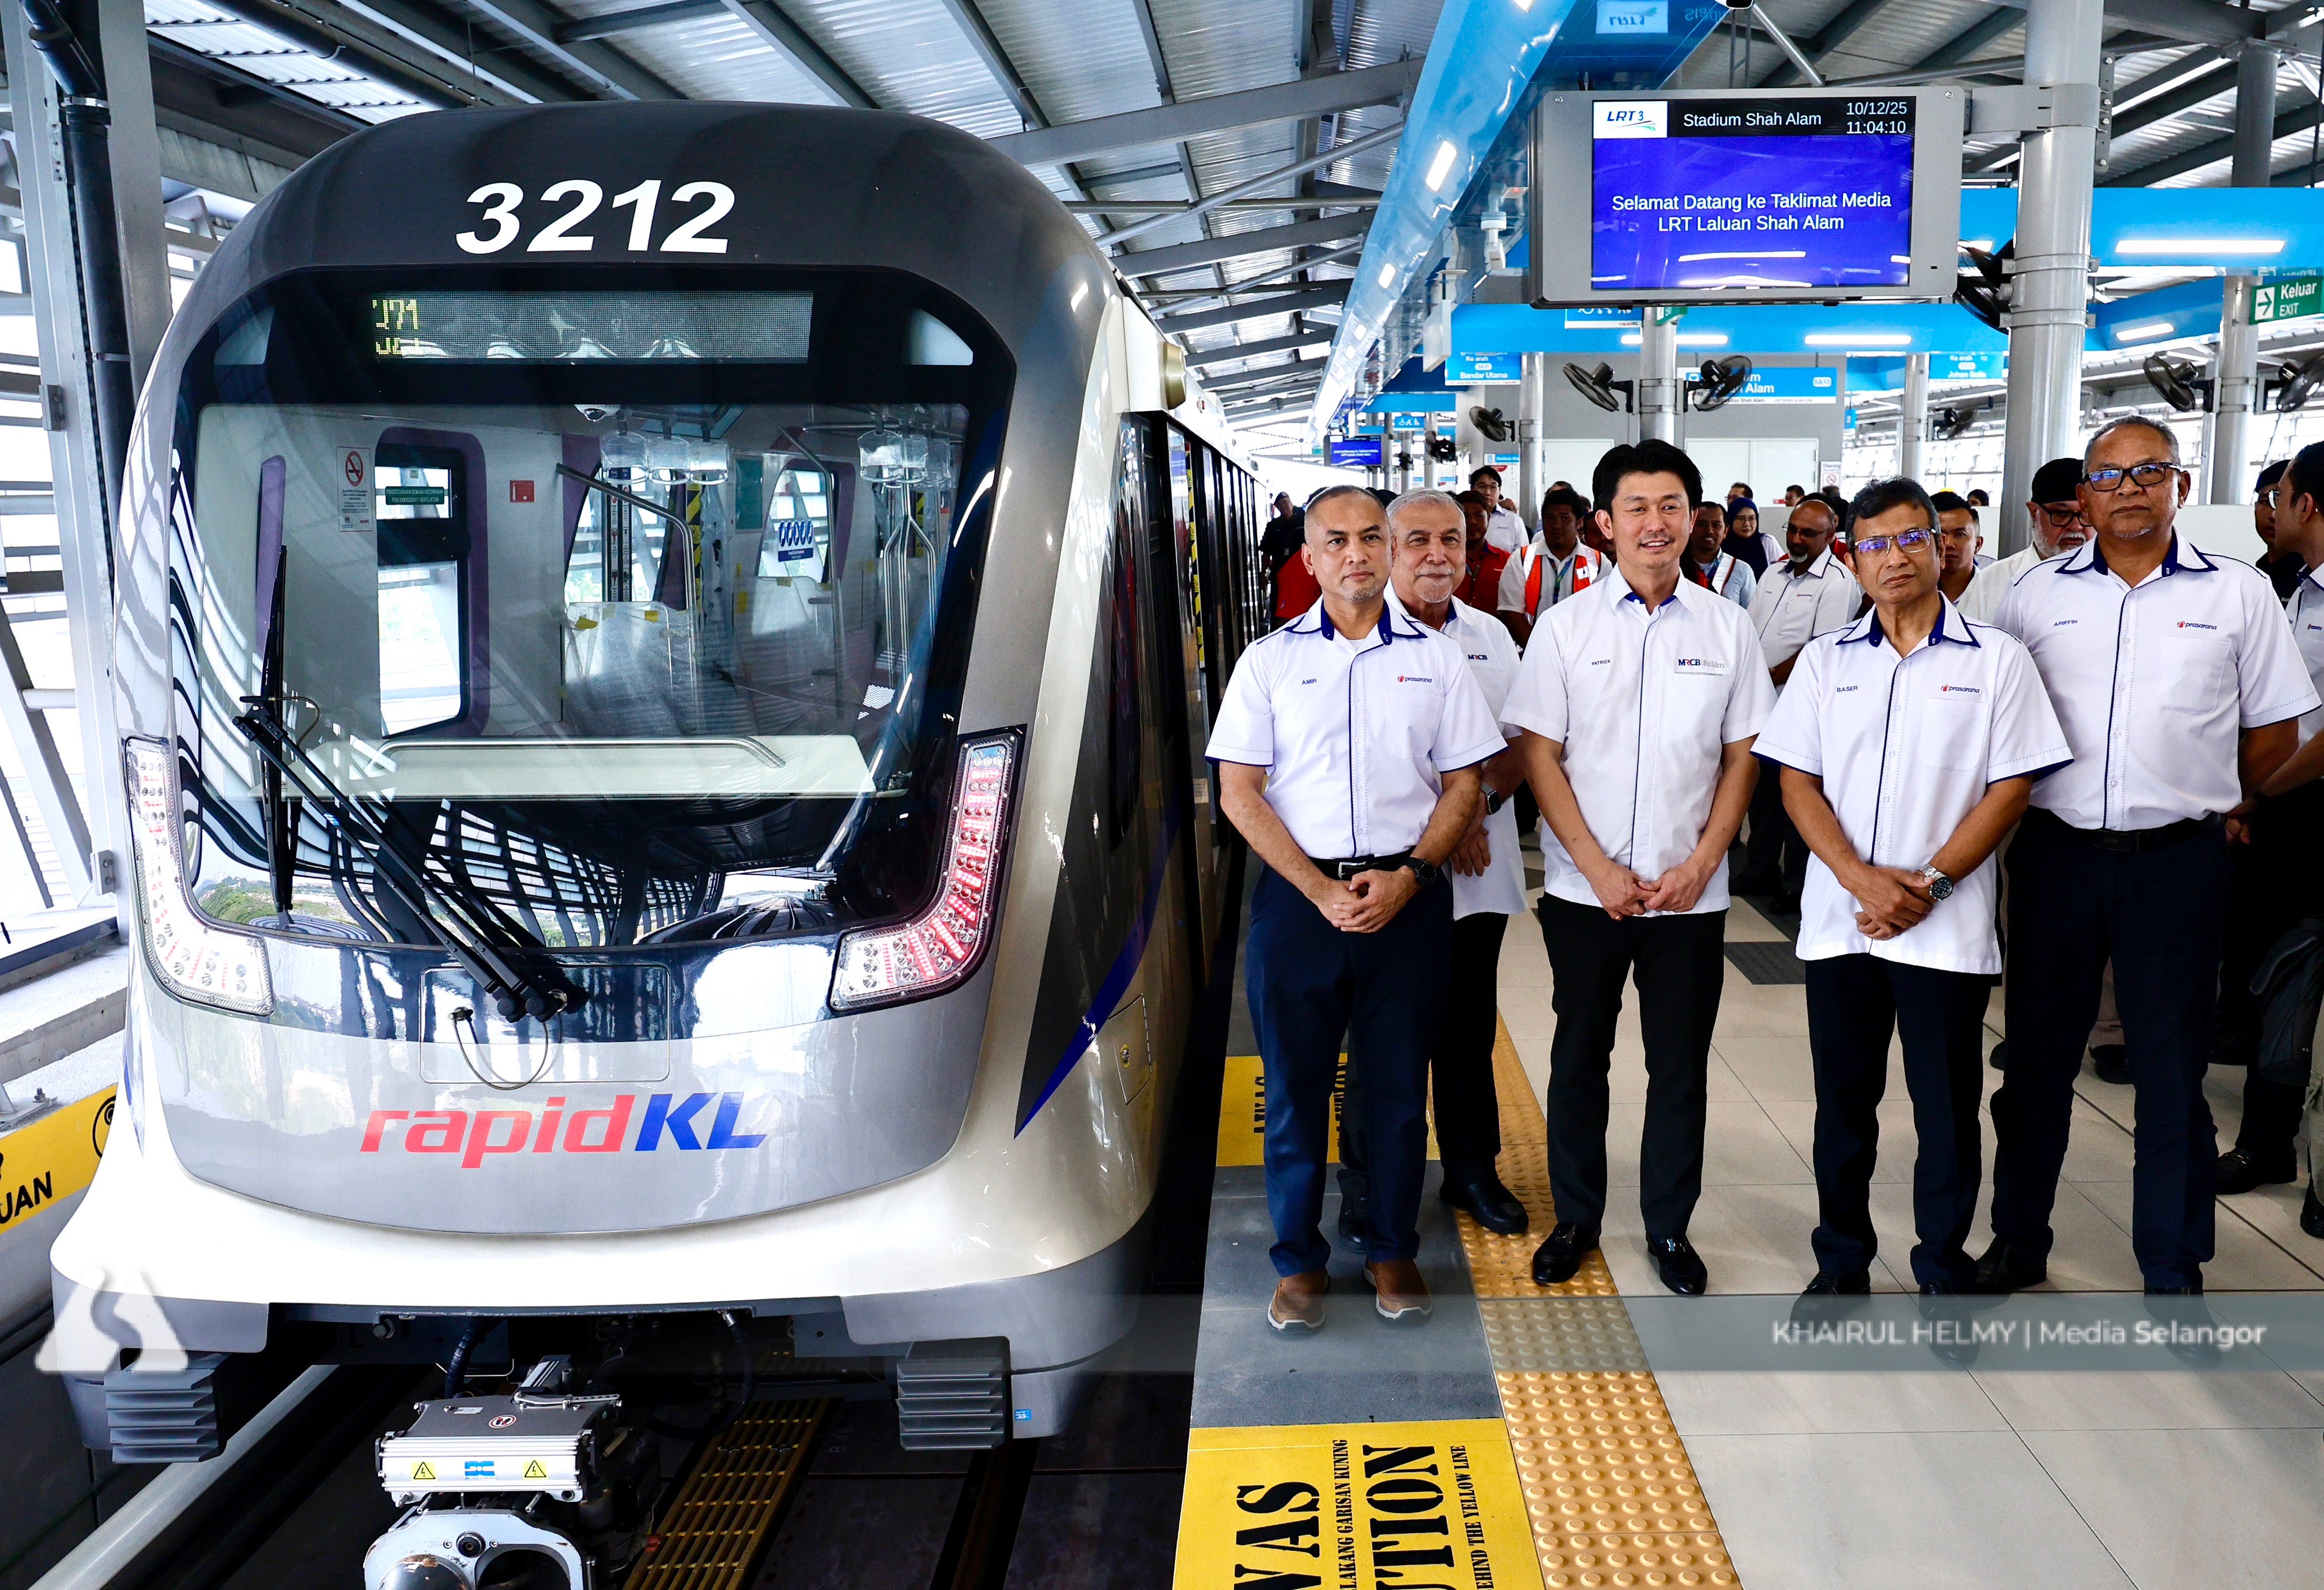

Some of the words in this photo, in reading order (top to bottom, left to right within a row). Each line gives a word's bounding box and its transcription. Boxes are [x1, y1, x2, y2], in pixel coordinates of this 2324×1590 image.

[1846, 101, 1907, 115] 10/12/25
[1684, 113, 1741, 127] Stadium
[1745, 112, 1782, 126] Shah
[1786, 112, 1821, 125] Alam
[1846, 120, 1906, 134] 11:04:10
[1612, 195, 1680, 210] Selamat
[1684, 195, 1742, 213] Datang
[1747, 194, 1766, 208] ke
[1771, 193, 1838, 208] Taklimat
[1842, 192, 1892, 208] Media
[456, 179, 735, 254] 3212
[1658, 216, 1693, 232] LRT
[1697, 216, 1750, 231] Laluan
[1756, 214, 1798, 230] Shah
[1802, 214, 1844, 229] Alam
[2281, 282, 2317, 300] Keluar
[2280, 302, 2299, 317] EXIT
[1745, 383, 1775, 393] Alam
[1678, 658, 1701, 666] MRCB
[1703, 659, 1725, 669] Builders
[360, 1092, 768, 1169] rapidKL
[1333, 1440, 1352, 1480] KUNING
[1450, 1445, 1470, 1470] LINE
[1457, 1473, 1482, 1519] YELLOW
[1334, 1483, 1353, 1534] GARISAN
[1465, 1522, 1485, 1547] THE
